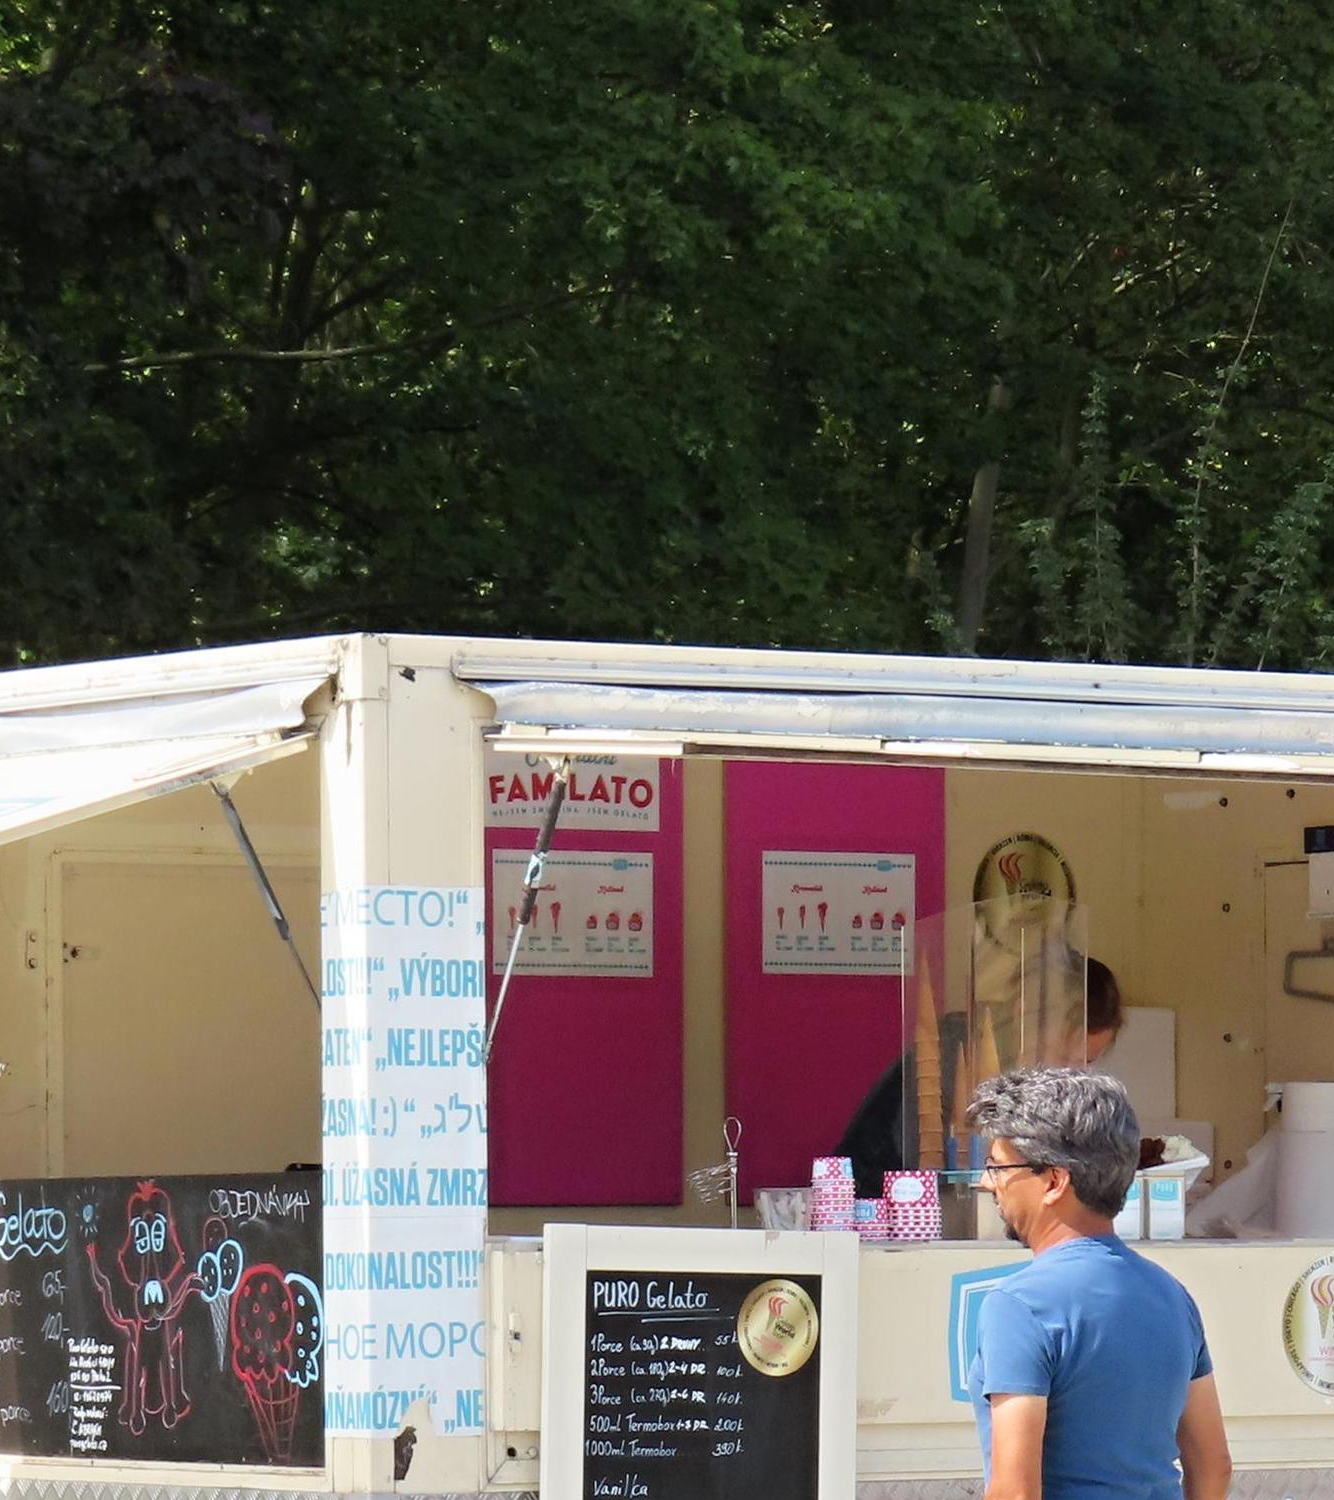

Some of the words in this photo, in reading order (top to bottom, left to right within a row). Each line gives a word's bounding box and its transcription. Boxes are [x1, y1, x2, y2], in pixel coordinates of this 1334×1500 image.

[489, 773, 653, 808] FAMLATO
[343, 1161, 420, 1206] ÚŽASNÁ
[594, 1281, 639, 1308] PURO
[646, 1281, 708, 1308] Gelato
[625, 1413, 676, 1431] Termobox
[629, 1439, 677, 1457] Termobox
[594, 1474, 648, 1498] Vanilka
